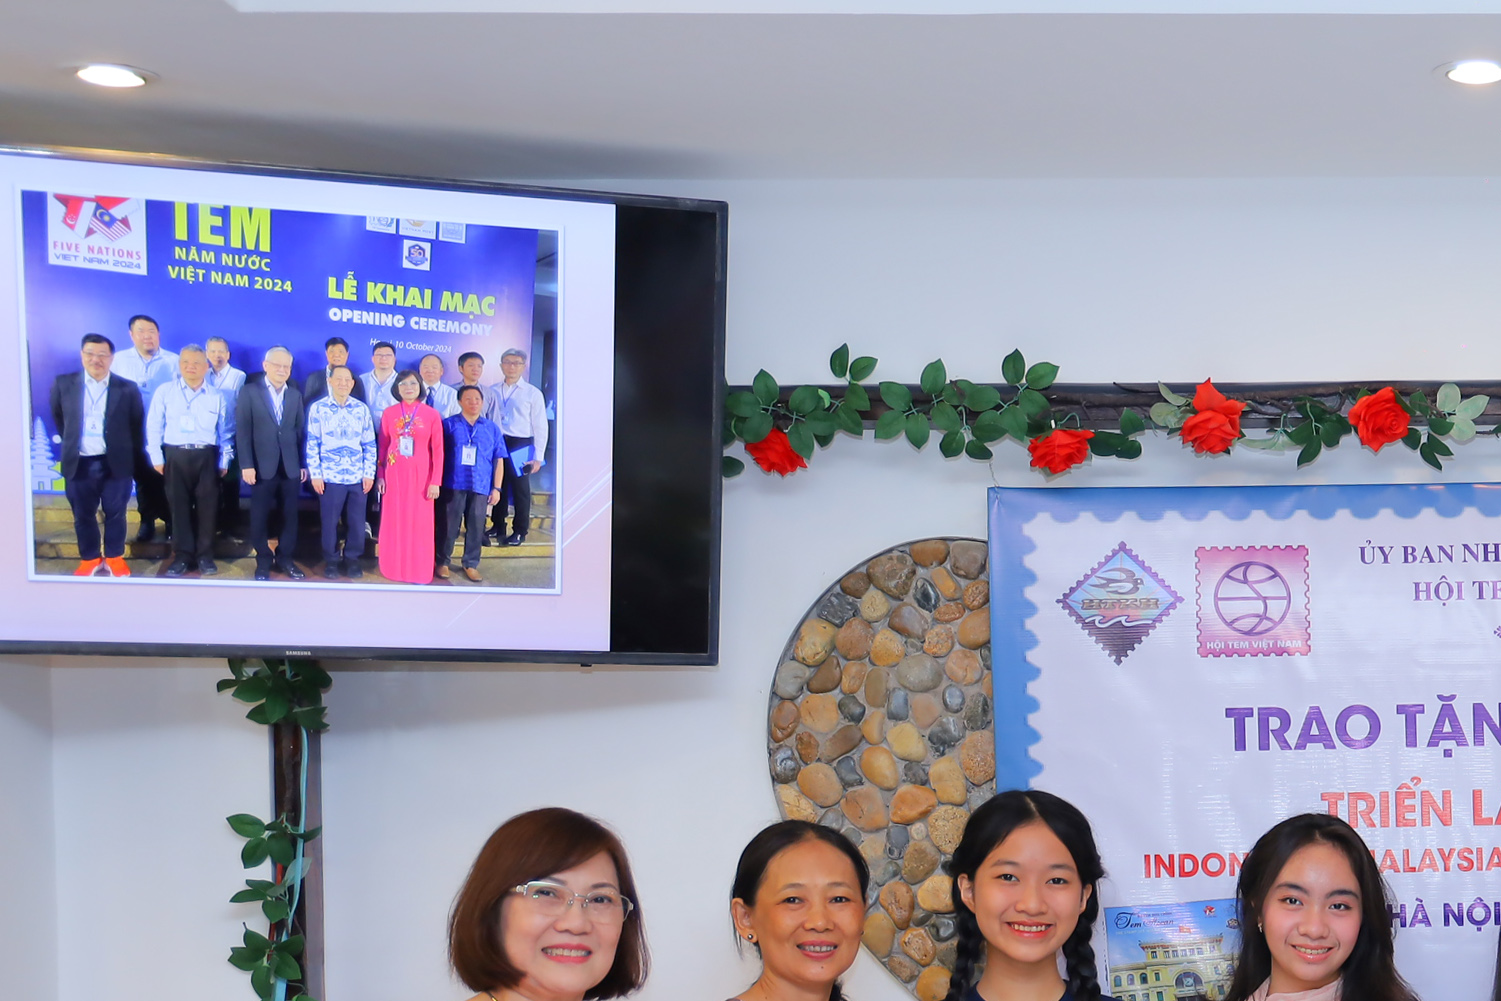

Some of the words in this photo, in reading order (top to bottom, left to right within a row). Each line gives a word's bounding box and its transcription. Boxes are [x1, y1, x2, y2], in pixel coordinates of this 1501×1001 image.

[53, 241, 80, 252] FIVE
[88, 245, 142, 260] NATIONS
[54, 253, 78, 262] VIET
[83, 256, 109, 265] NAM
[112, 260, 142, 270] 2024
[174, 246, 215, 264] NĂM
[222, 252, 271, 271] NƯỚC
[168, 265, 206, 284] VIỆT
[210, 272, 250, 288] NAM
[254, 276, 293, 292] 2024
[328, 271, 357, 301] LỄ
[367, 282, 432, 310] KHAI
[440, 291, 496, 320] MẠC
[329, 308, 406, 328] OPENING
[410, 317, 493, 336] CEREMONY
[406, 342, 434, 352] October
[1359, 539, 1394, 565] ỦY
[1402, 544, 1454, 564] BAN
[1081, 598, 1160, 610] HTKH
[1412, 576, 1464, 606] HỘI
[1206, 639, 1226, 651] HỘI
[1228, 640, 1248, 649] TEM
[1251, 638, 1275, 650] VIỆT
[1276, 639, 1302, 648] NAM
[1224, 704, 1382, 752] TRAO
[1320, 776, 1452, 828] TRIỂN
[1144, 852, 1250, 878] INDON
[1114, 912, 1142, 929] Tem
[1386, 898, 1432, 928] HÀ
[1444, 896, 1501, 932] NỘI
